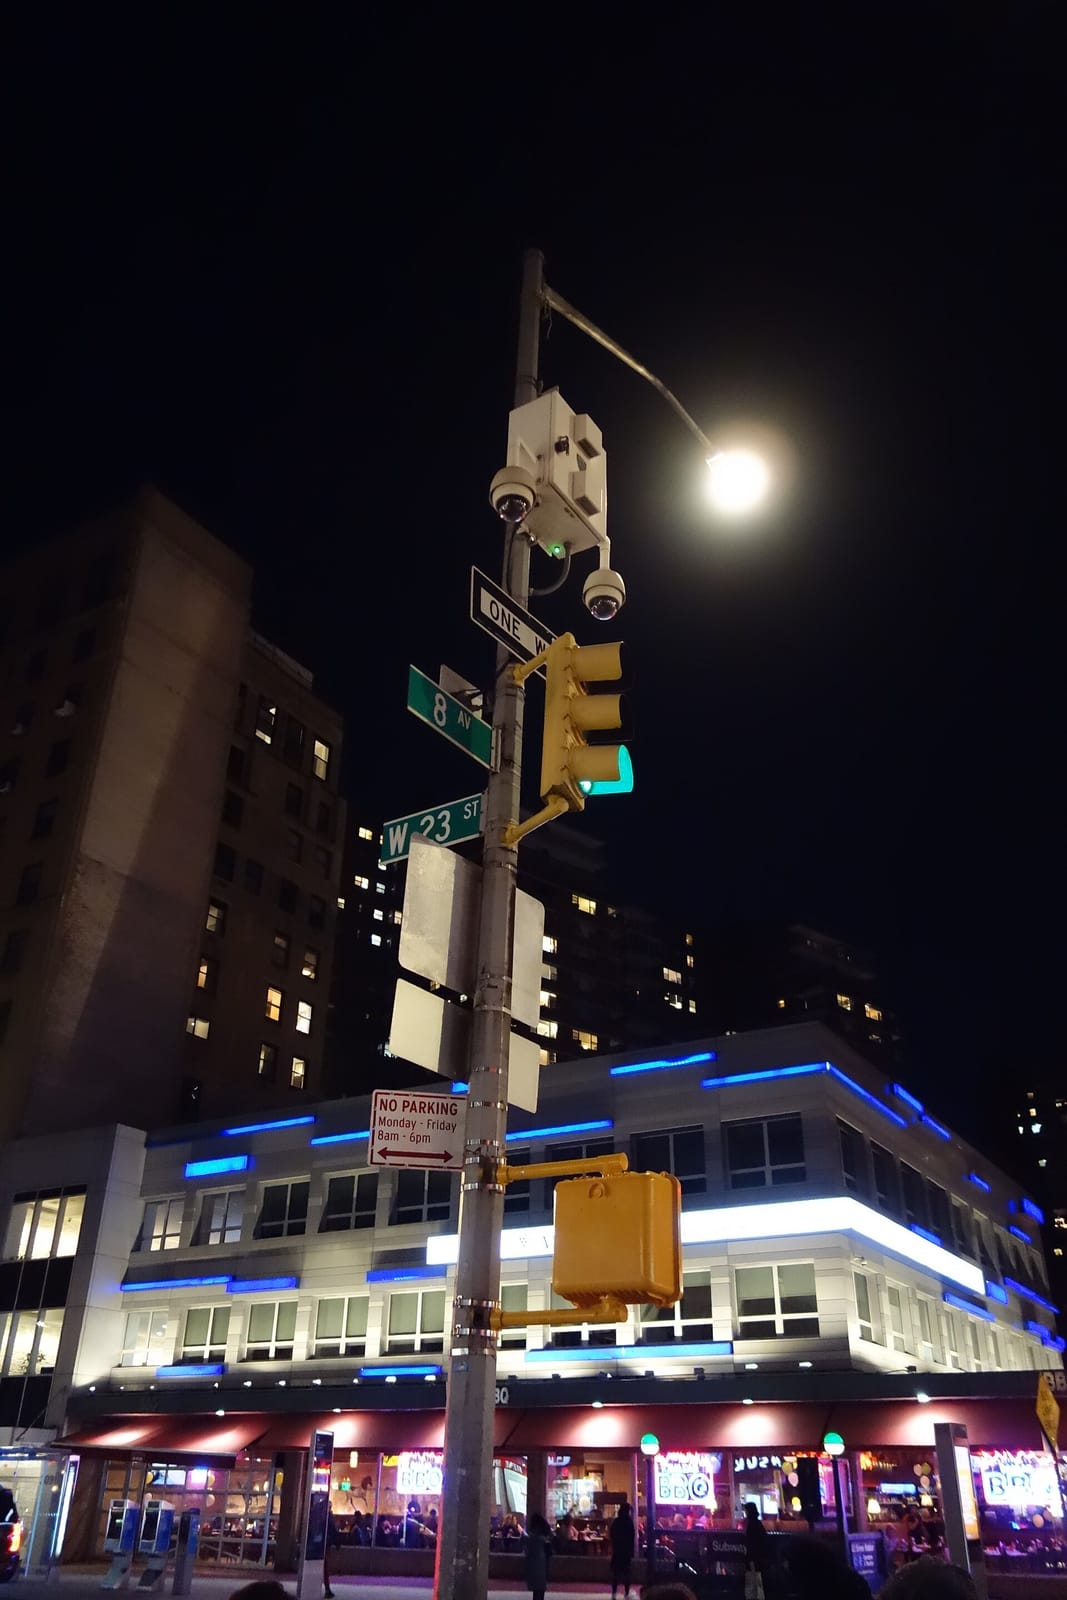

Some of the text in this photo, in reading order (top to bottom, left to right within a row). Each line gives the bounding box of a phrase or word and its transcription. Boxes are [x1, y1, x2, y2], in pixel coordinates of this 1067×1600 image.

[489, 601, 521, 640] ONE
[433, 693, 472, 730] 8 AV
[389, 800, 479, 856] W 23 ST
[379, 1098, 458, 1116] NO PARKING
[378, 1116, 416, 1131] Monday
[426, 1119, 457, 1133] Friday
[377, 1130, 399, 1142] 8am
[409, 1132, 431, 1145] 6pm
[712, 1540, 747, 1557] Subway
